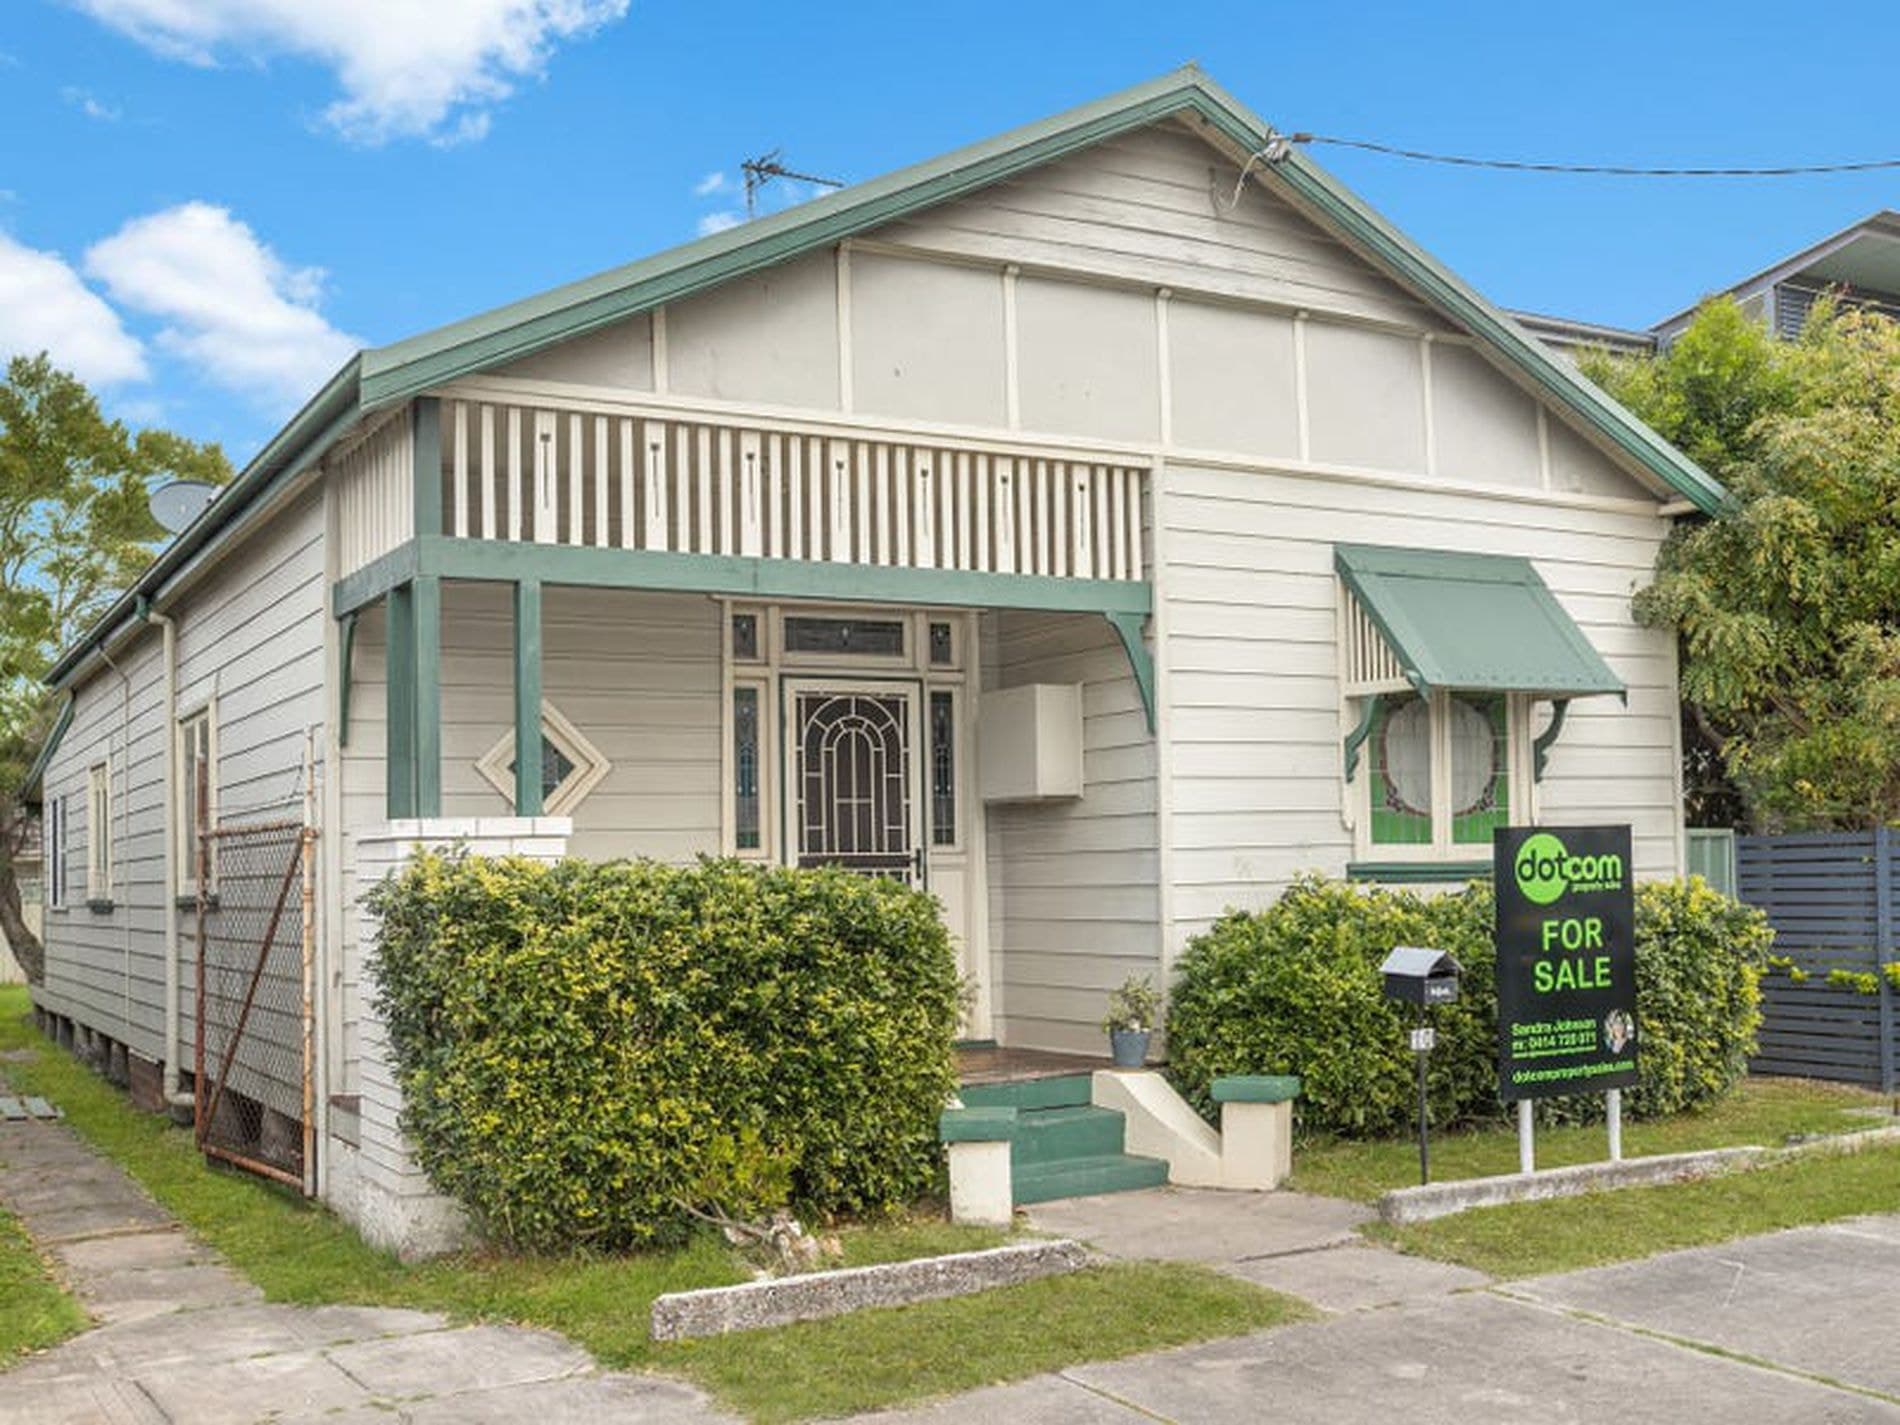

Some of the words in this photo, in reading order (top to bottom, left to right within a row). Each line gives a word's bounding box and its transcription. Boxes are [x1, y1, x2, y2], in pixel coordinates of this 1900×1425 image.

[1518, 849, 1623, 881] dotcom
[1542, 917, 1603, 951] FOR
[1534, 956, 1612, 992] SALE
